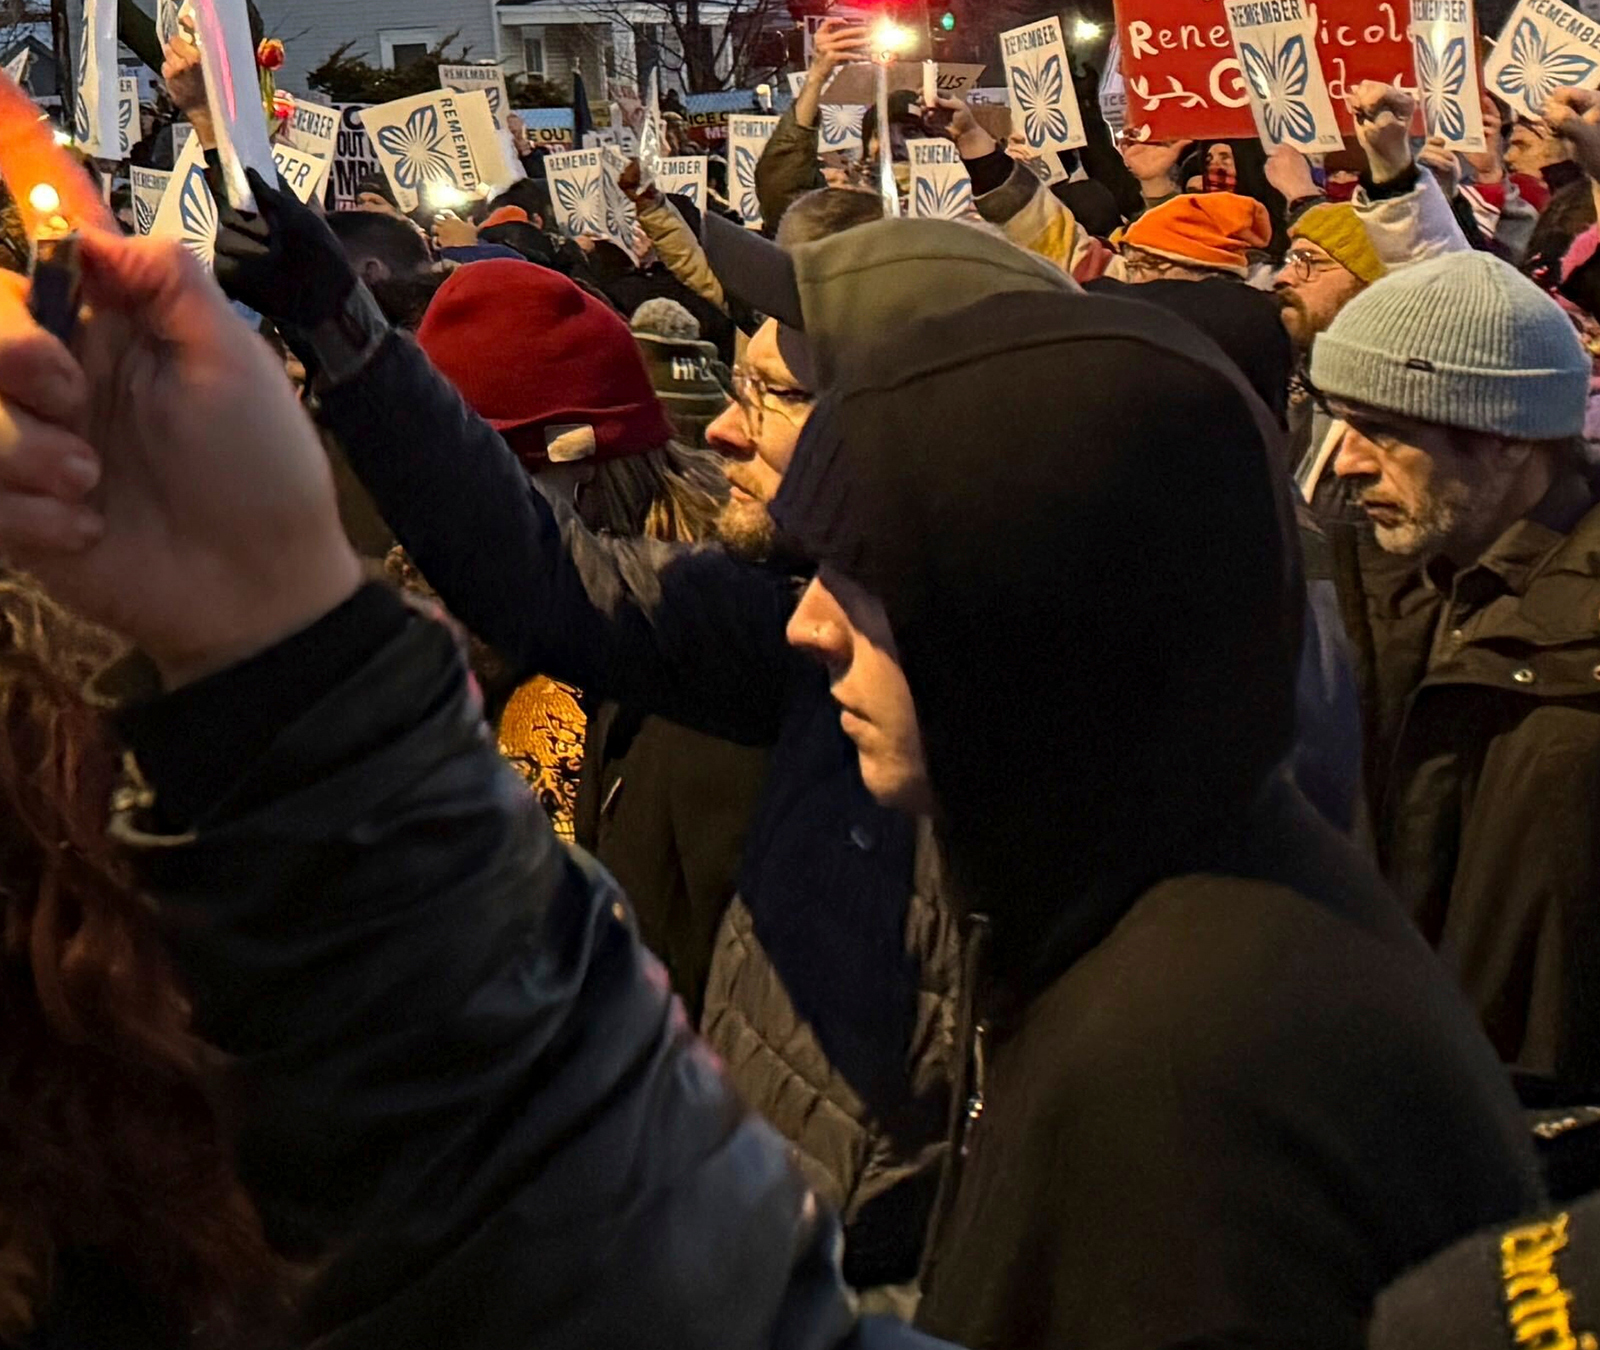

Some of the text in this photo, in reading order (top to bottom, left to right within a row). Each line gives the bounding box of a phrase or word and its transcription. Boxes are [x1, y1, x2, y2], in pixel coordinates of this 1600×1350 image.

[1308, 3, 1414, 46] icol
[442, 68, 500, 81] REMEMBER
[548, 152, 599, 171] REMEMB
